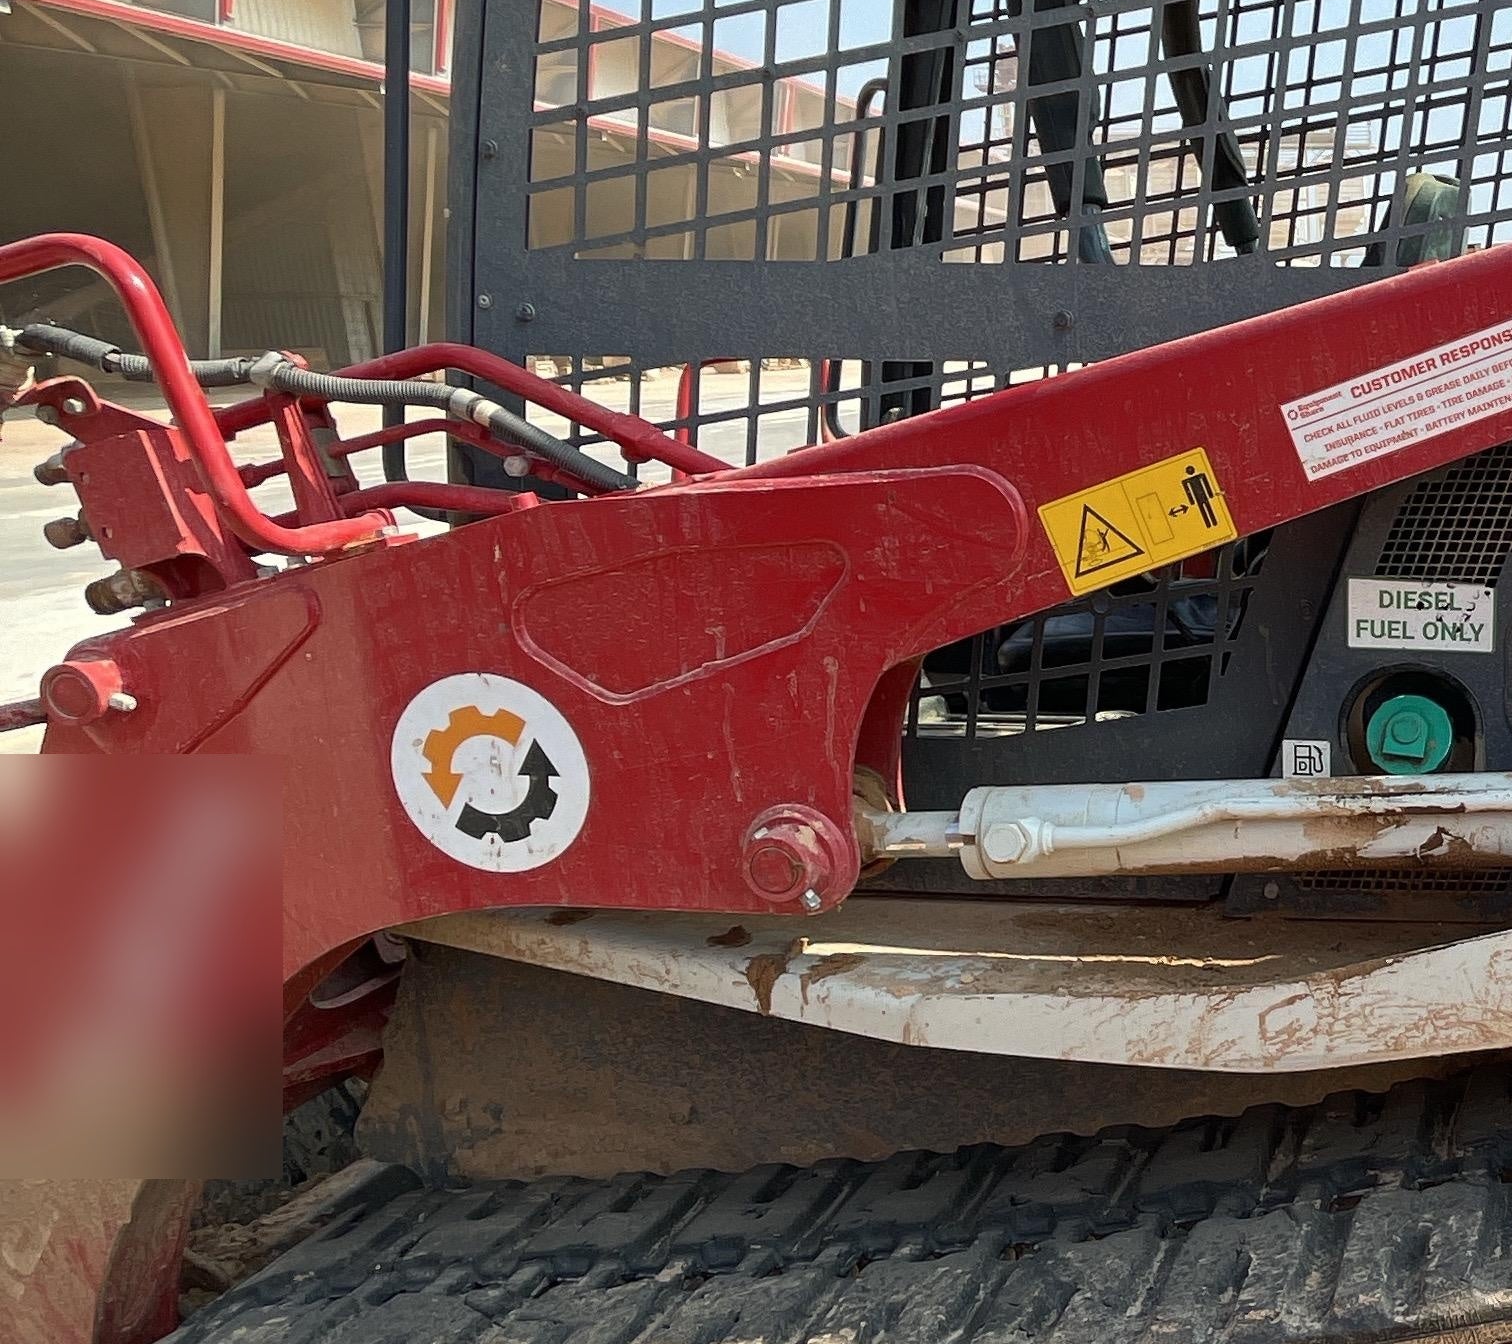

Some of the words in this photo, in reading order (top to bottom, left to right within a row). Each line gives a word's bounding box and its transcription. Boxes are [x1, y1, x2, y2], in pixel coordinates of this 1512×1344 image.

[1304, 426, 1334, 443] CHECK
[1336, 419, 1353, 433] ALL
[1353, 409, 1382, 426] FLUID
[1382, 396, 1416, 415] LEVELS
[1424, 378, 1463, 399] GREASE
[1463, 367, 1491, 385] DAILY
[1351, 358, 1437, 399] CUSTOMER
[1310, 453, 1350, 474] DAMAGE
[1351, 448, 1364, 460] TO
[1364, 428, 1420, 455] EQUIPMENT
[1425, 408, 1468, 433] BATTERY
[1324, 427, 1379, 453] INSURANCE
[1384, 414, 1407, 431] FLAT
[1406, 406, 1436, 423] TIRES
[1440, 394, 1464, 410] TIRE
[1465, 379, 1507, 401] DAMAGE
[1377, 589, 1461, 612] DIESEL
[1355, 619, 1415, 641] FUEL
[1422, 620, 1484, 643] ONLY
